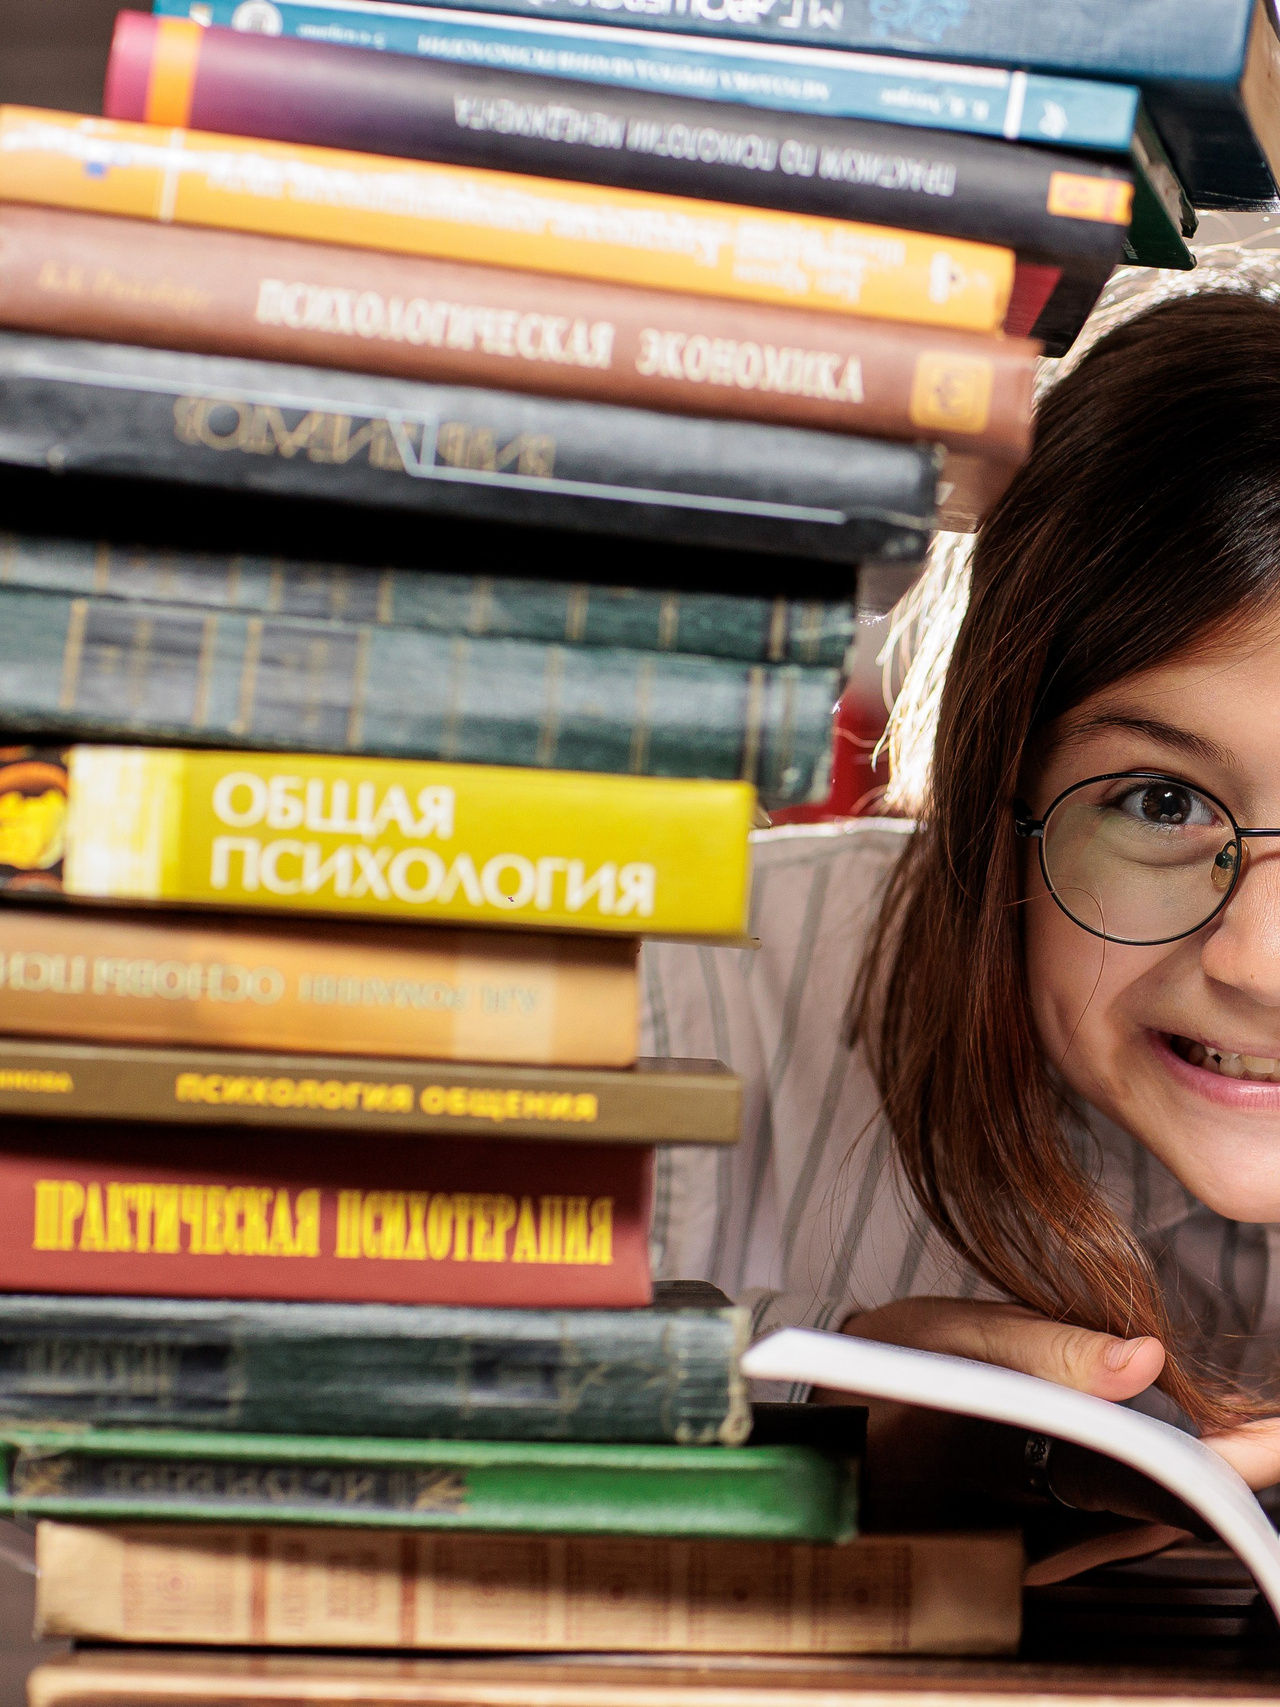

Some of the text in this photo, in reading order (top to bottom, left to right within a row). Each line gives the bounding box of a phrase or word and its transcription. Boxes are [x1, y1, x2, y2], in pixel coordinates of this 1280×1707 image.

[452, 93, 956, 196] ПРАКТИКУМ ПО ПСИХОЛОГИИ МЕНЕДЖМЕНТА
[256, 279, 616, 369] ПСИХОЛОГИЧЕСКАЯ
[634, 328, 865, 404] ЭКОНОМИКА
[212, 770, 455, 840] ОБЩАЯ
[211, 838, 654, 916] ПСИХОЛОГИЯ
[92, 955, 285, 1005] ОСНОВЫ
[175, 1072, 600, 1124] ПСИХОЛОГИЯ ОБЩЕНИЯ
[32, 1180, 614, 1266] ПРАКТИЧЕСКАЯ ПСИХОТЕРАПИЯ
